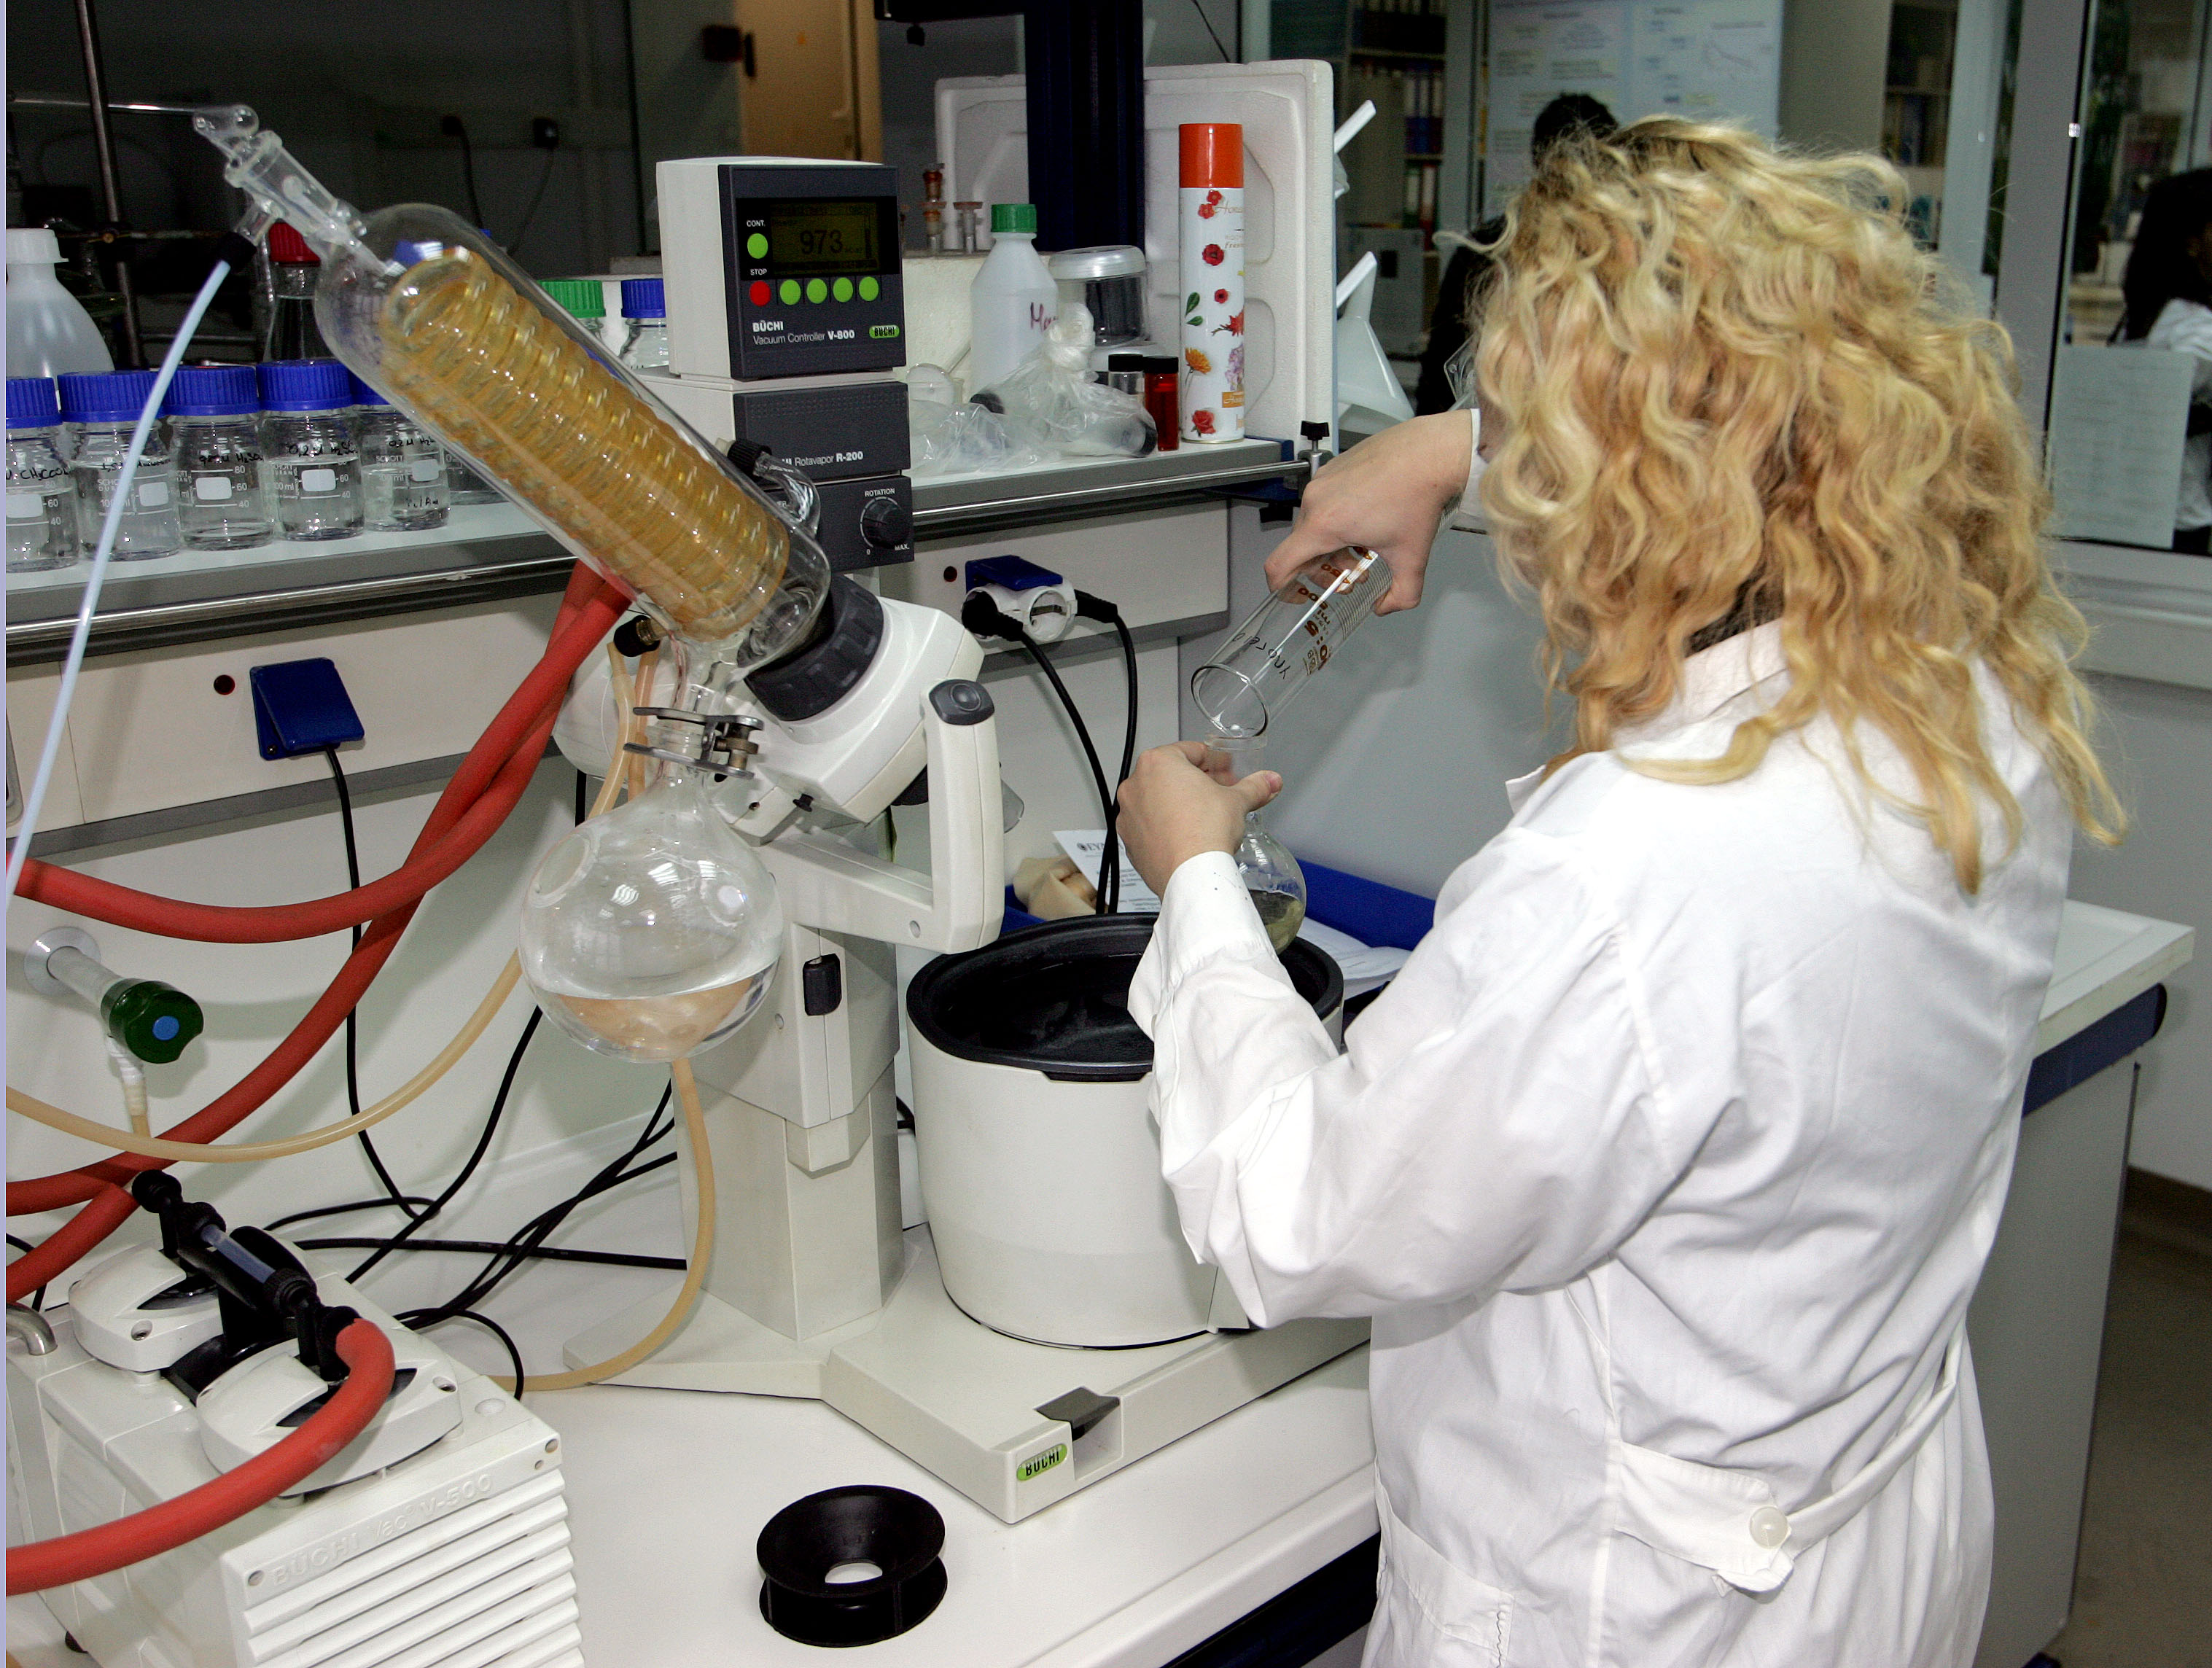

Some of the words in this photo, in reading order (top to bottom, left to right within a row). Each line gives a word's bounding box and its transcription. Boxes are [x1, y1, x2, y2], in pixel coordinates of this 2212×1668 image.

[747, 219, 766, 227] CONT.
[800, 230, 844, 254] 973
[753, 335, 786, 345] Vacuum
[787, 332, 826, 343] Controller
[827, 330, 855, 340] V-800
[795, 456, 834, 466] Rotavapor
[836, 451, 863, 462] R-200
[235, 465, 246, 474] 80
[340, 473, 349, 482] 60
[236, 483, 248, 491] 60
[864, 488, 895, 496] ROTATION
[47, 499, 59, 507] 60
[238, 499, 249, 508] 40
[50, 517, 61, 526] 40
